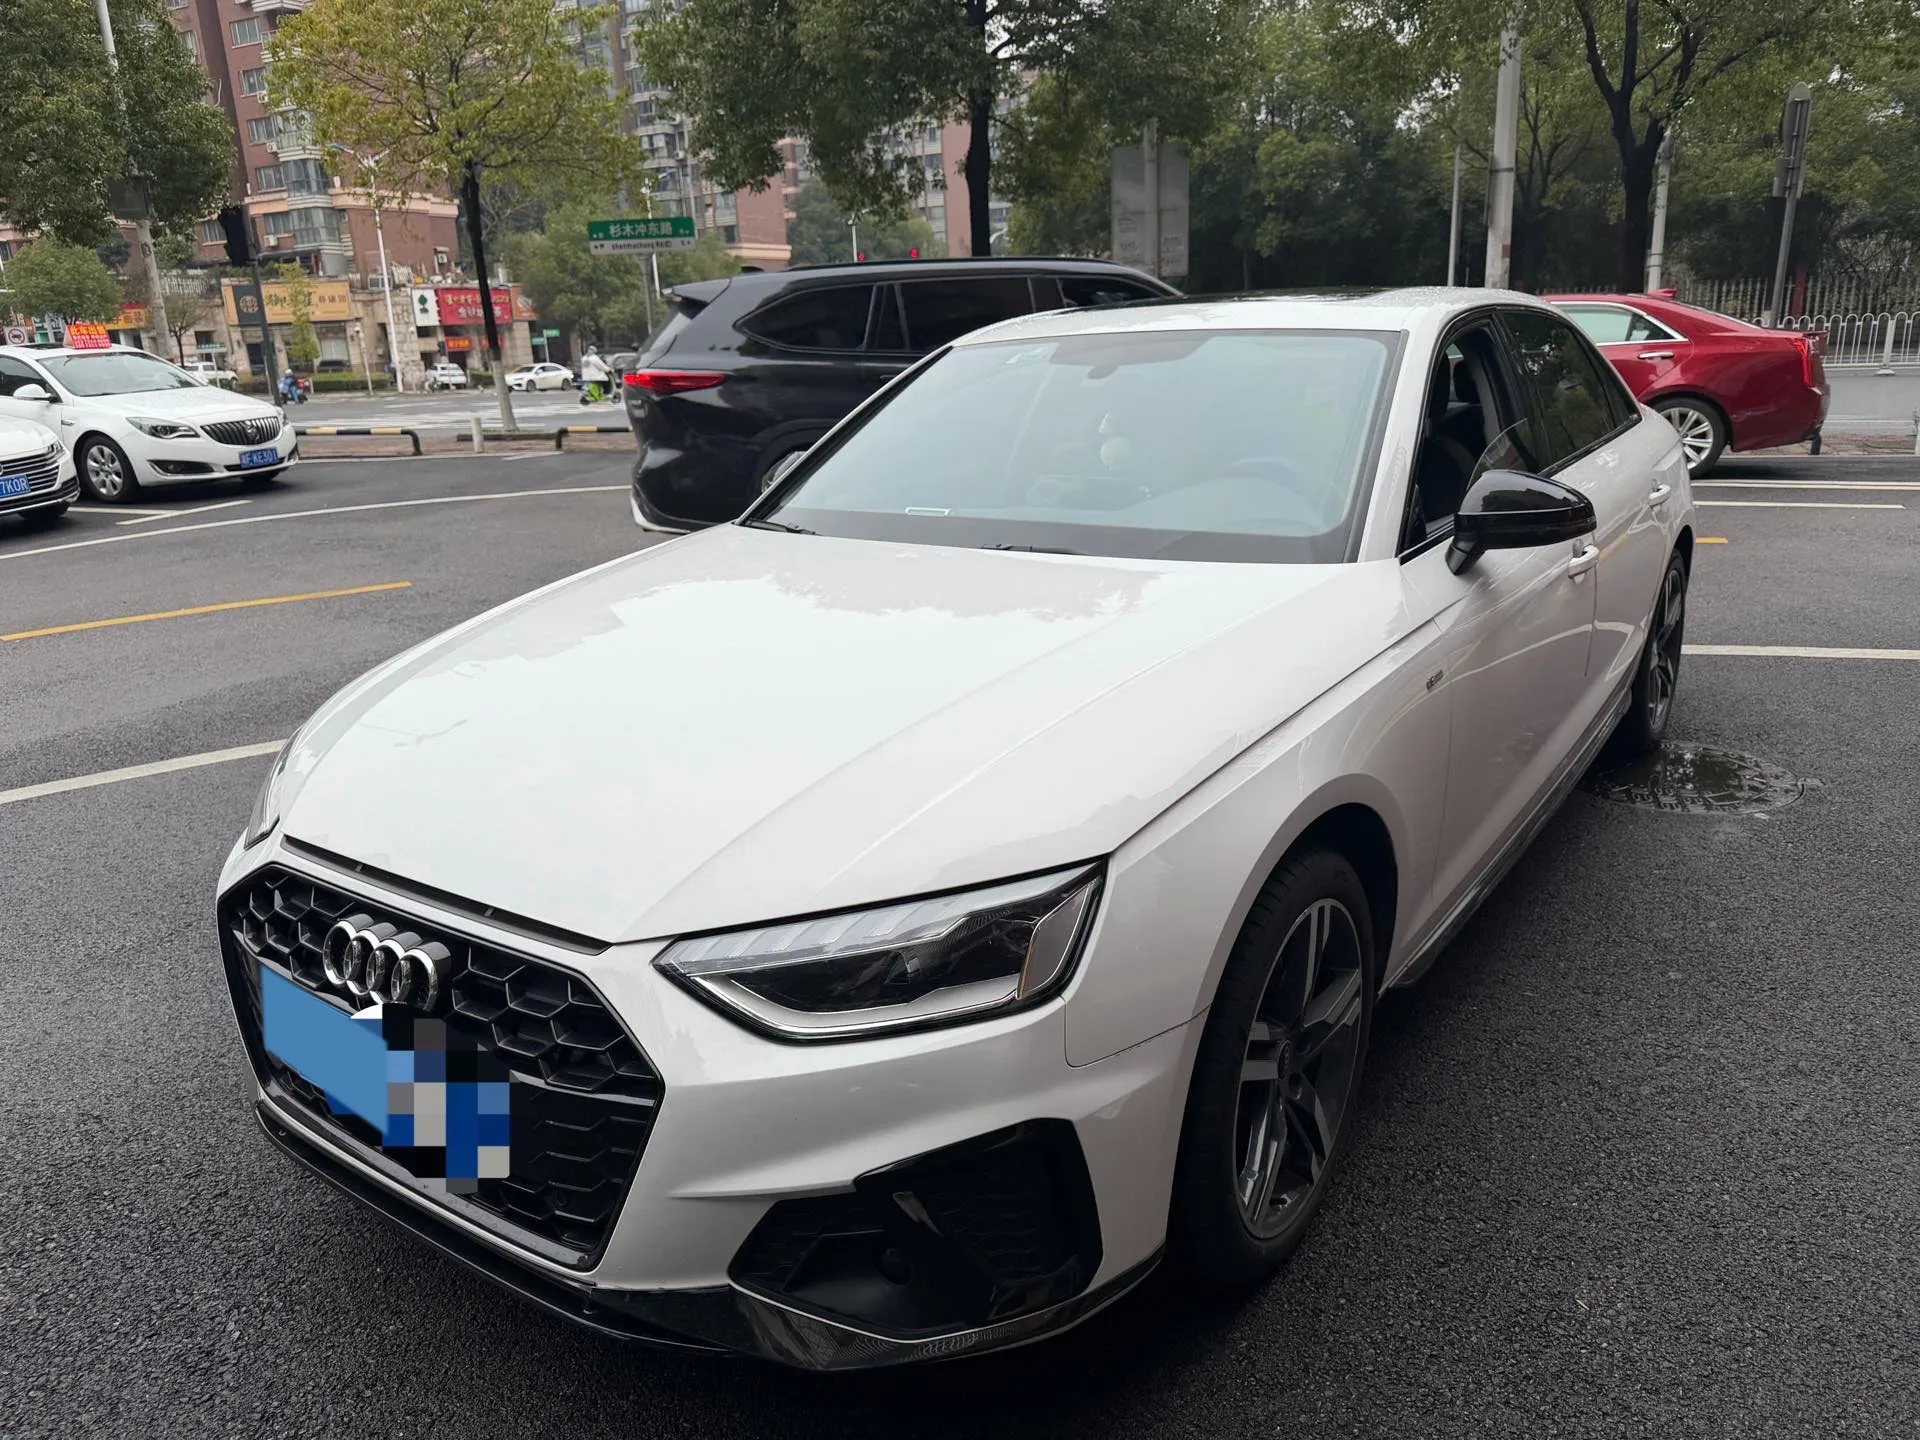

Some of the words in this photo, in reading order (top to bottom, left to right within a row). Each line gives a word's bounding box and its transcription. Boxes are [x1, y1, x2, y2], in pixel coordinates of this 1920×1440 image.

[609, 221, 673, 238] 杉木冲东路
